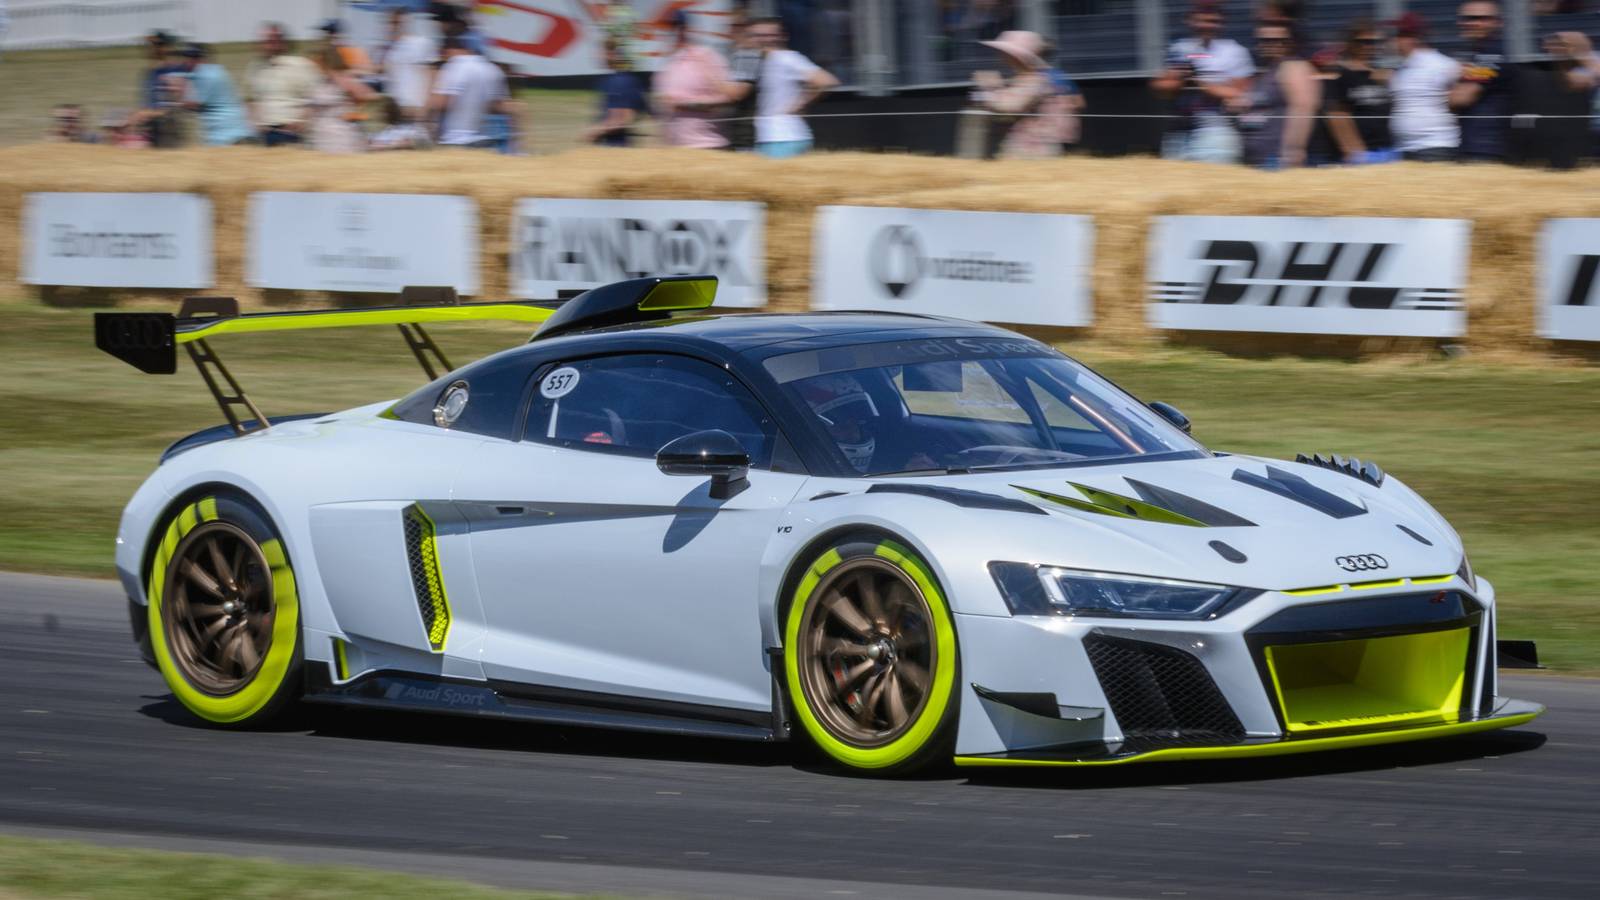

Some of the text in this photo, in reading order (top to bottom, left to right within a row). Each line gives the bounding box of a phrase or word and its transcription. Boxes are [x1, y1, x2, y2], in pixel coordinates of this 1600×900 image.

[515, 215, 752, 286] RANDOX
[1194, 239, 1400, 309] DHL
[547, 374, 574, 391] 557
[406, 687, 485, 705] Audi Sport
